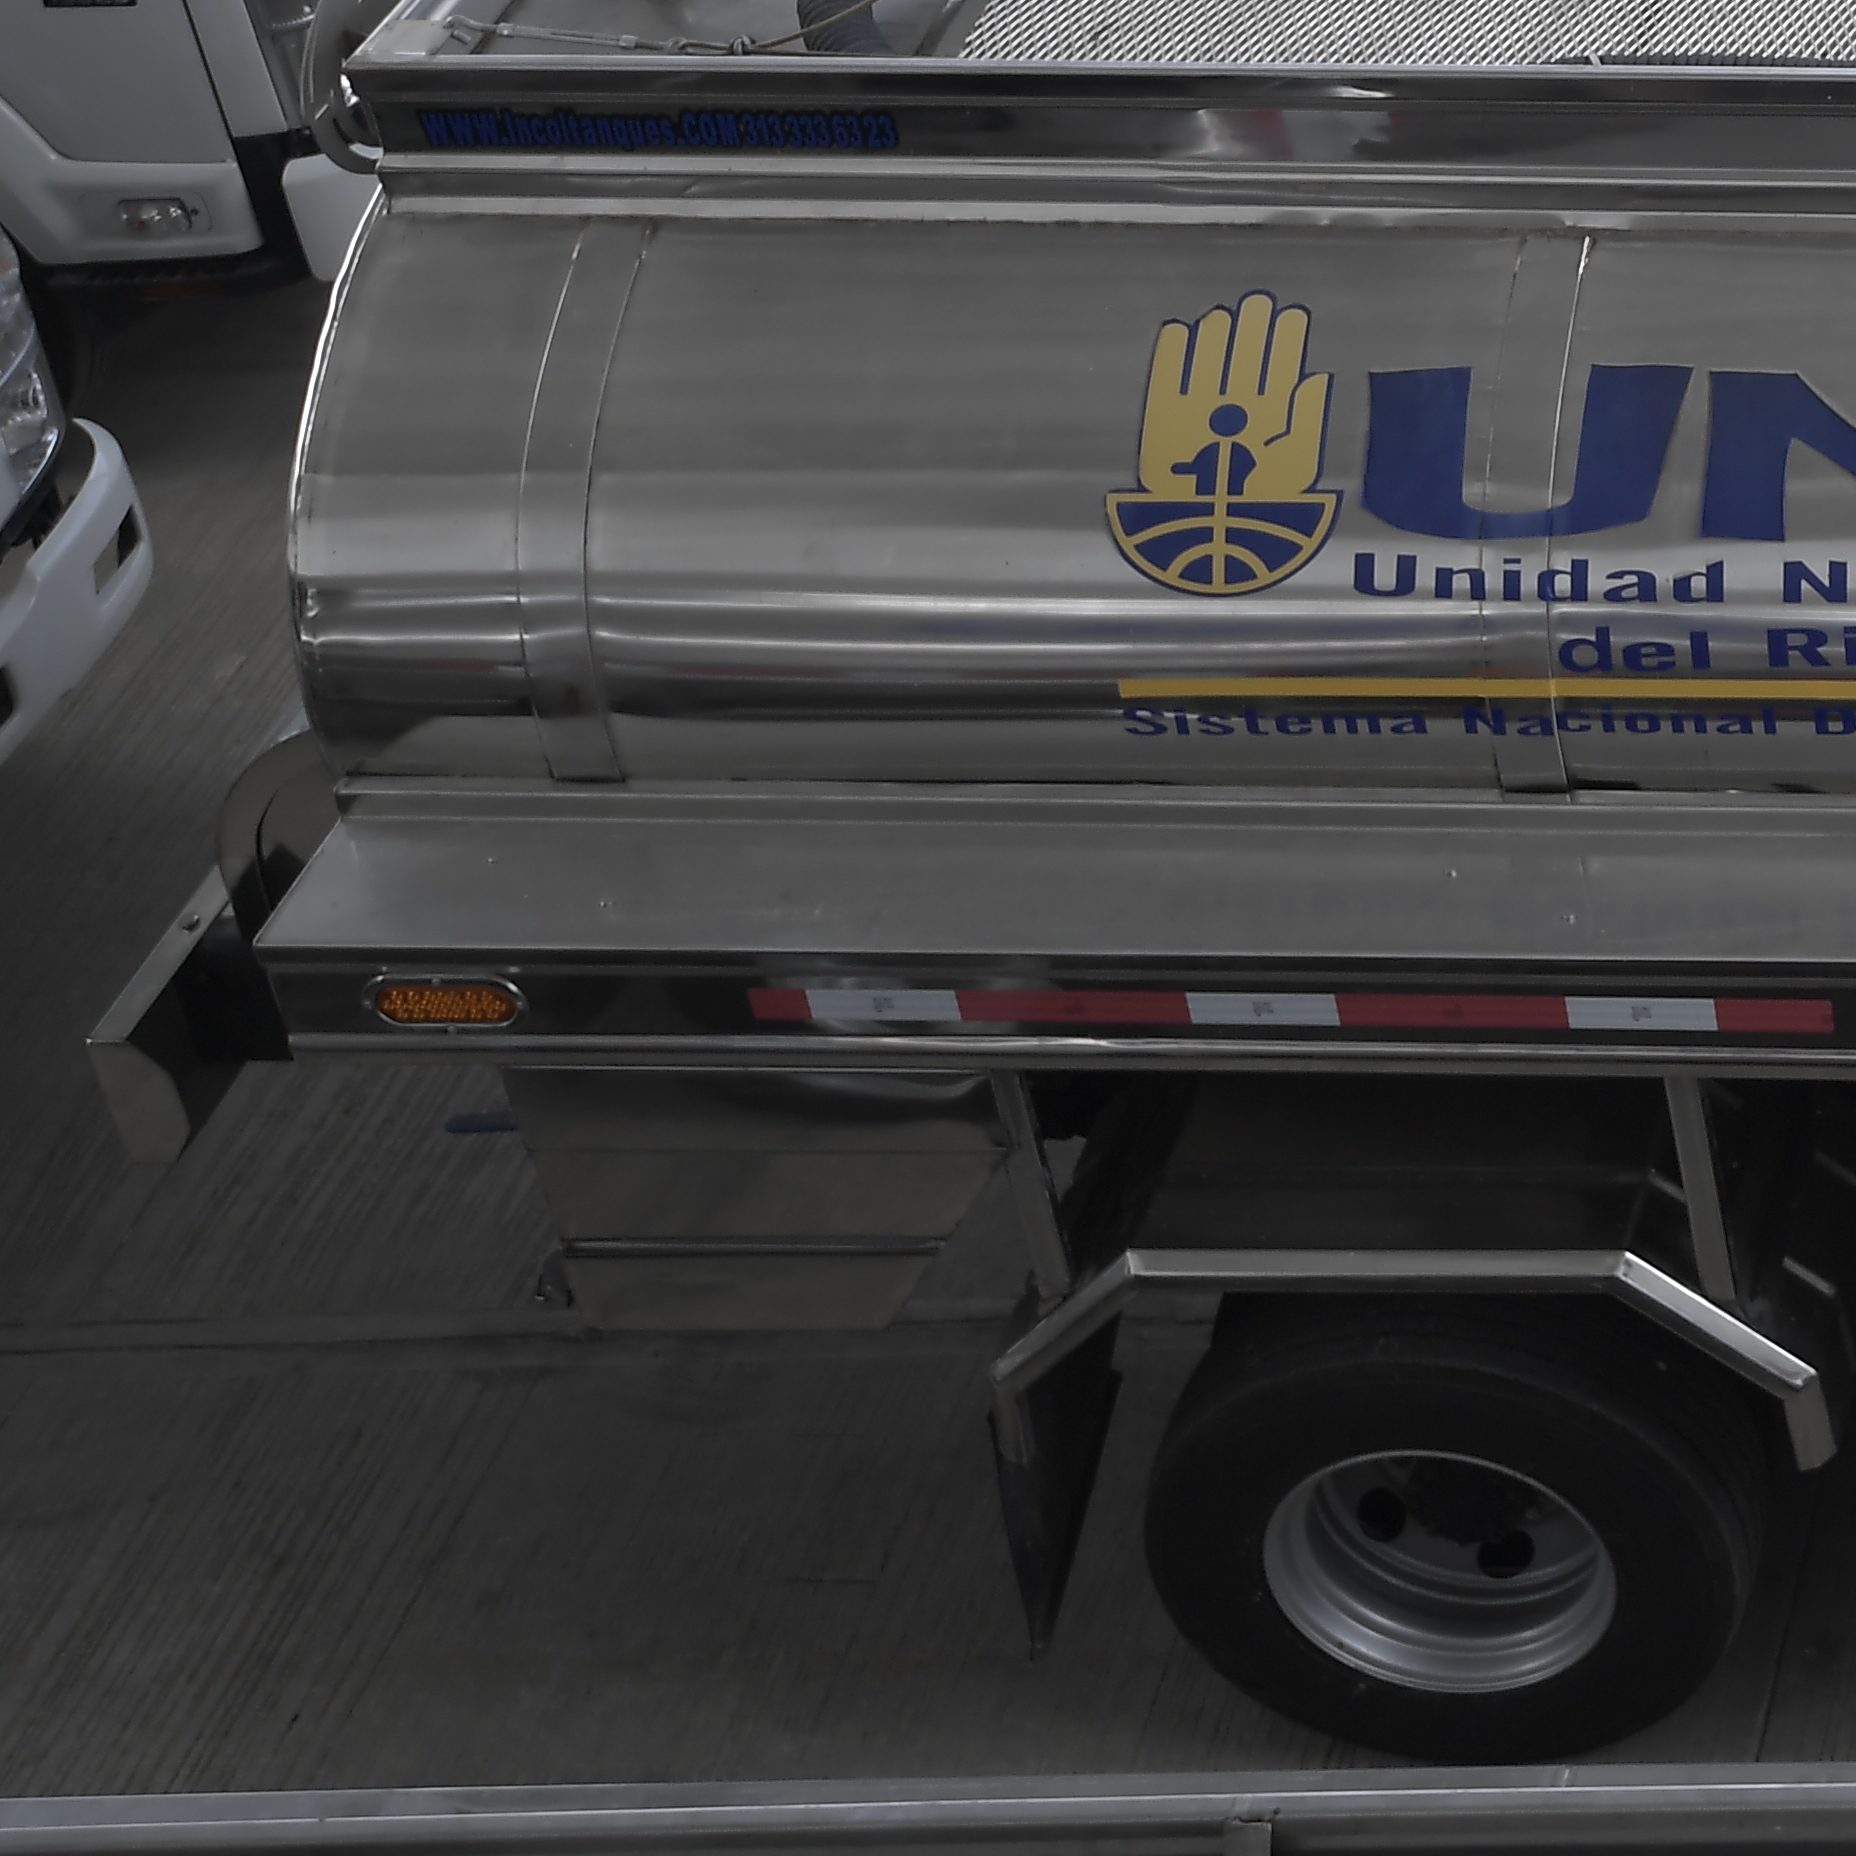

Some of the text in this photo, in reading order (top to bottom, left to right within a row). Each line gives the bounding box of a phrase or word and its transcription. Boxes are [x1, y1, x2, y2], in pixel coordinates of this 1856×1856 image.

[1354, 551, 1726, 604] Unidad
[1559, 626, 1711, 673] del
[1124, 706, 1428, 736] Sistema
[1462, 706, 1777, 736] Nacional
